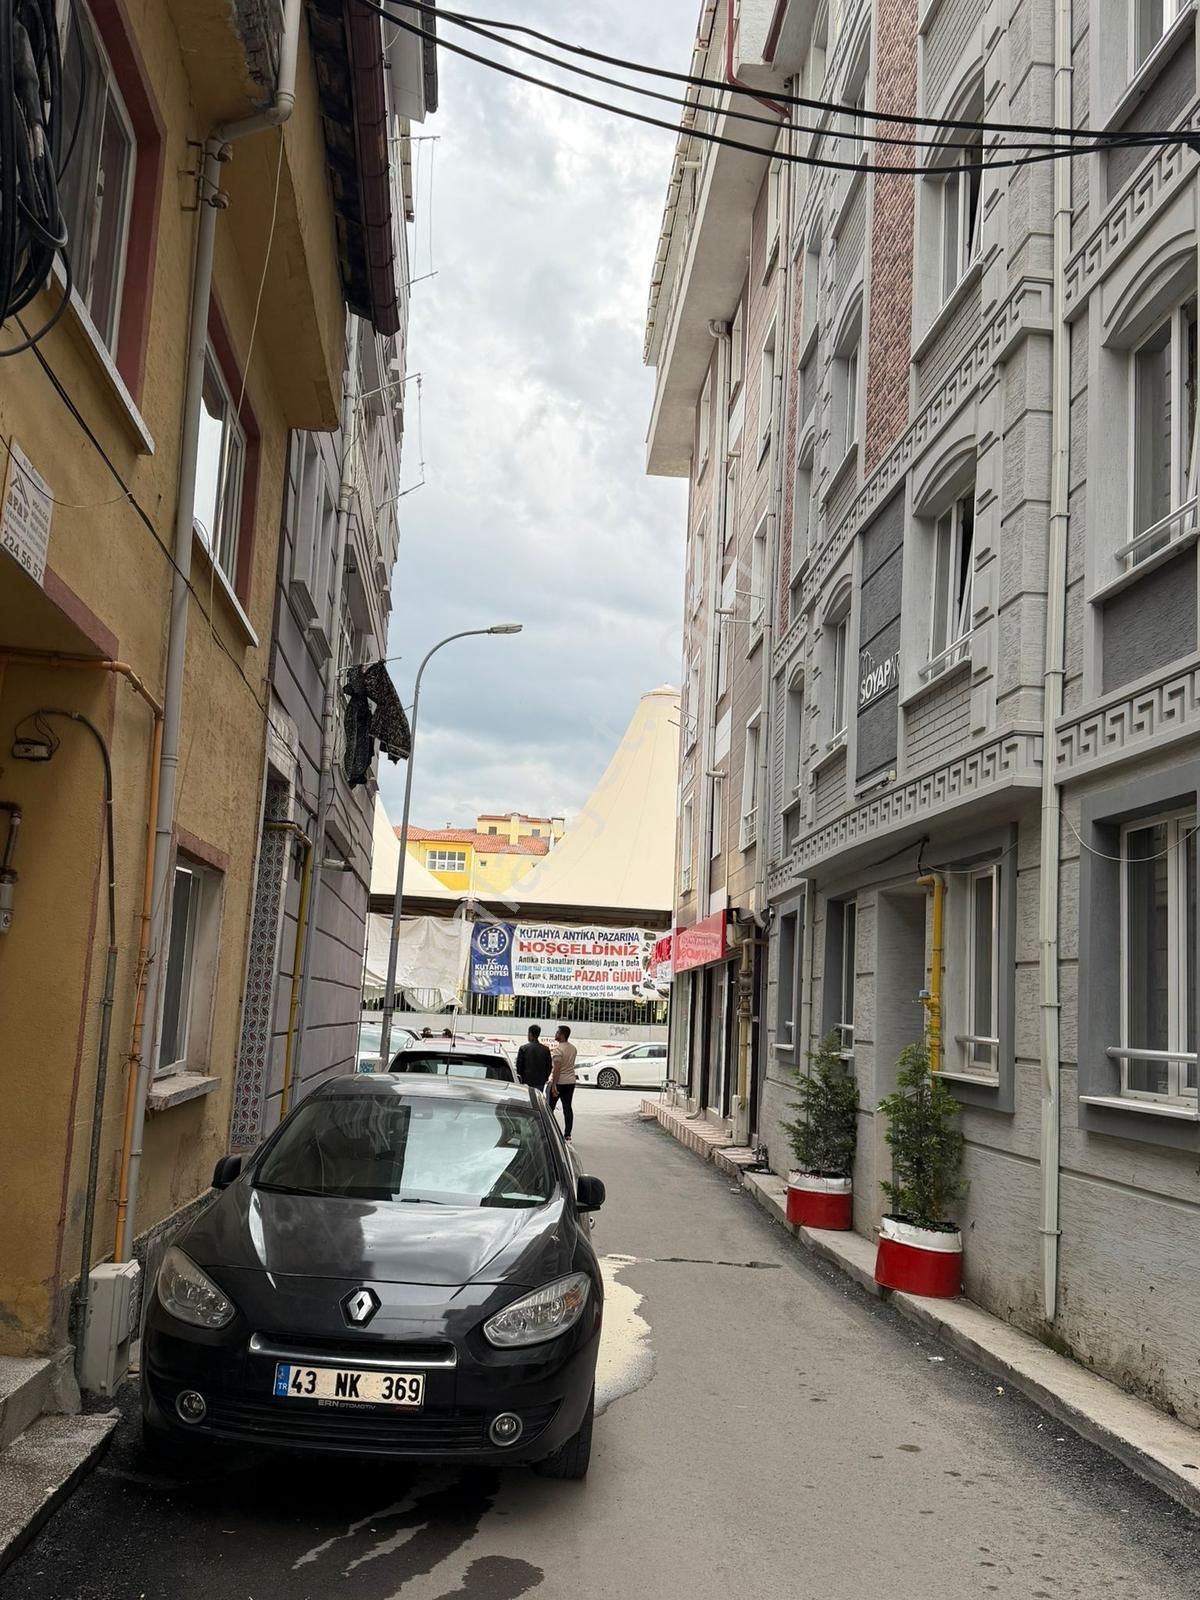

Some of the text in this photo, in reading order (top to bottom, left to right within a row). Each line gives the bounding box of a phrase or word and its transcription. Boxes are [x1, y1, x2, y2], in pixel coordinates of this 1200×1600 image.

[3, 533, 43, 582] 224 56 57
[597, 931, 640, 942] PAZARINA
[519, 941, 639, 956] HOŞGELDİNİZ
[612, 968, 642, 983] GÜNÜ
[277, 1382, 288, 1391] TR
[291, 1369, 420, 1402] 43 NK 369
